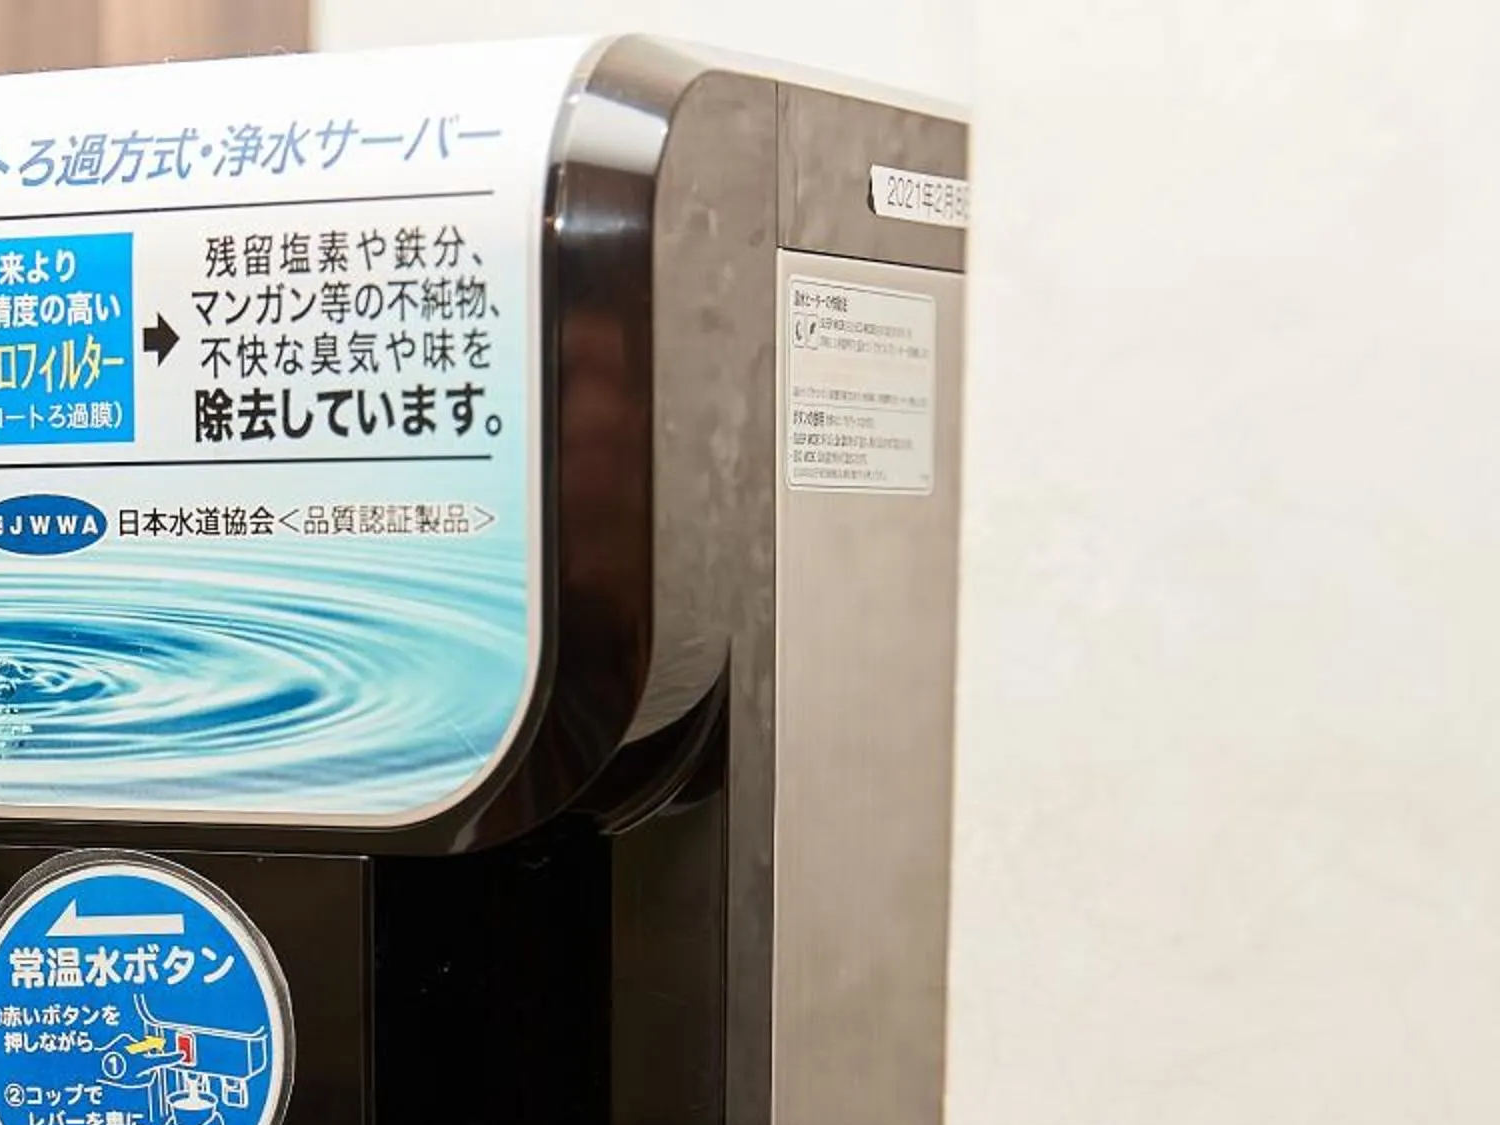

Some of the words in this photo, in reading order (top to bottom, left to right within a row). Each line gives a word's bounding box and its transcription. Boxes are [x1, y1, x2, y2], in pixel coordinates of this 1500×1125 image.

[205, 225, 483, 278] 残留塩素や鉄分、
[191, 276, 500, 326] マンガン等の不純物、
[200, 327, 492, 379] 不快な臭気や味を
[195, 381, 502, 443] 除去しています。
[9, 514, 99, 536] JWWA
[9, 945, 235, 989] 常温水ボタン
[3, 1031, 94, 1053] 押しながら
